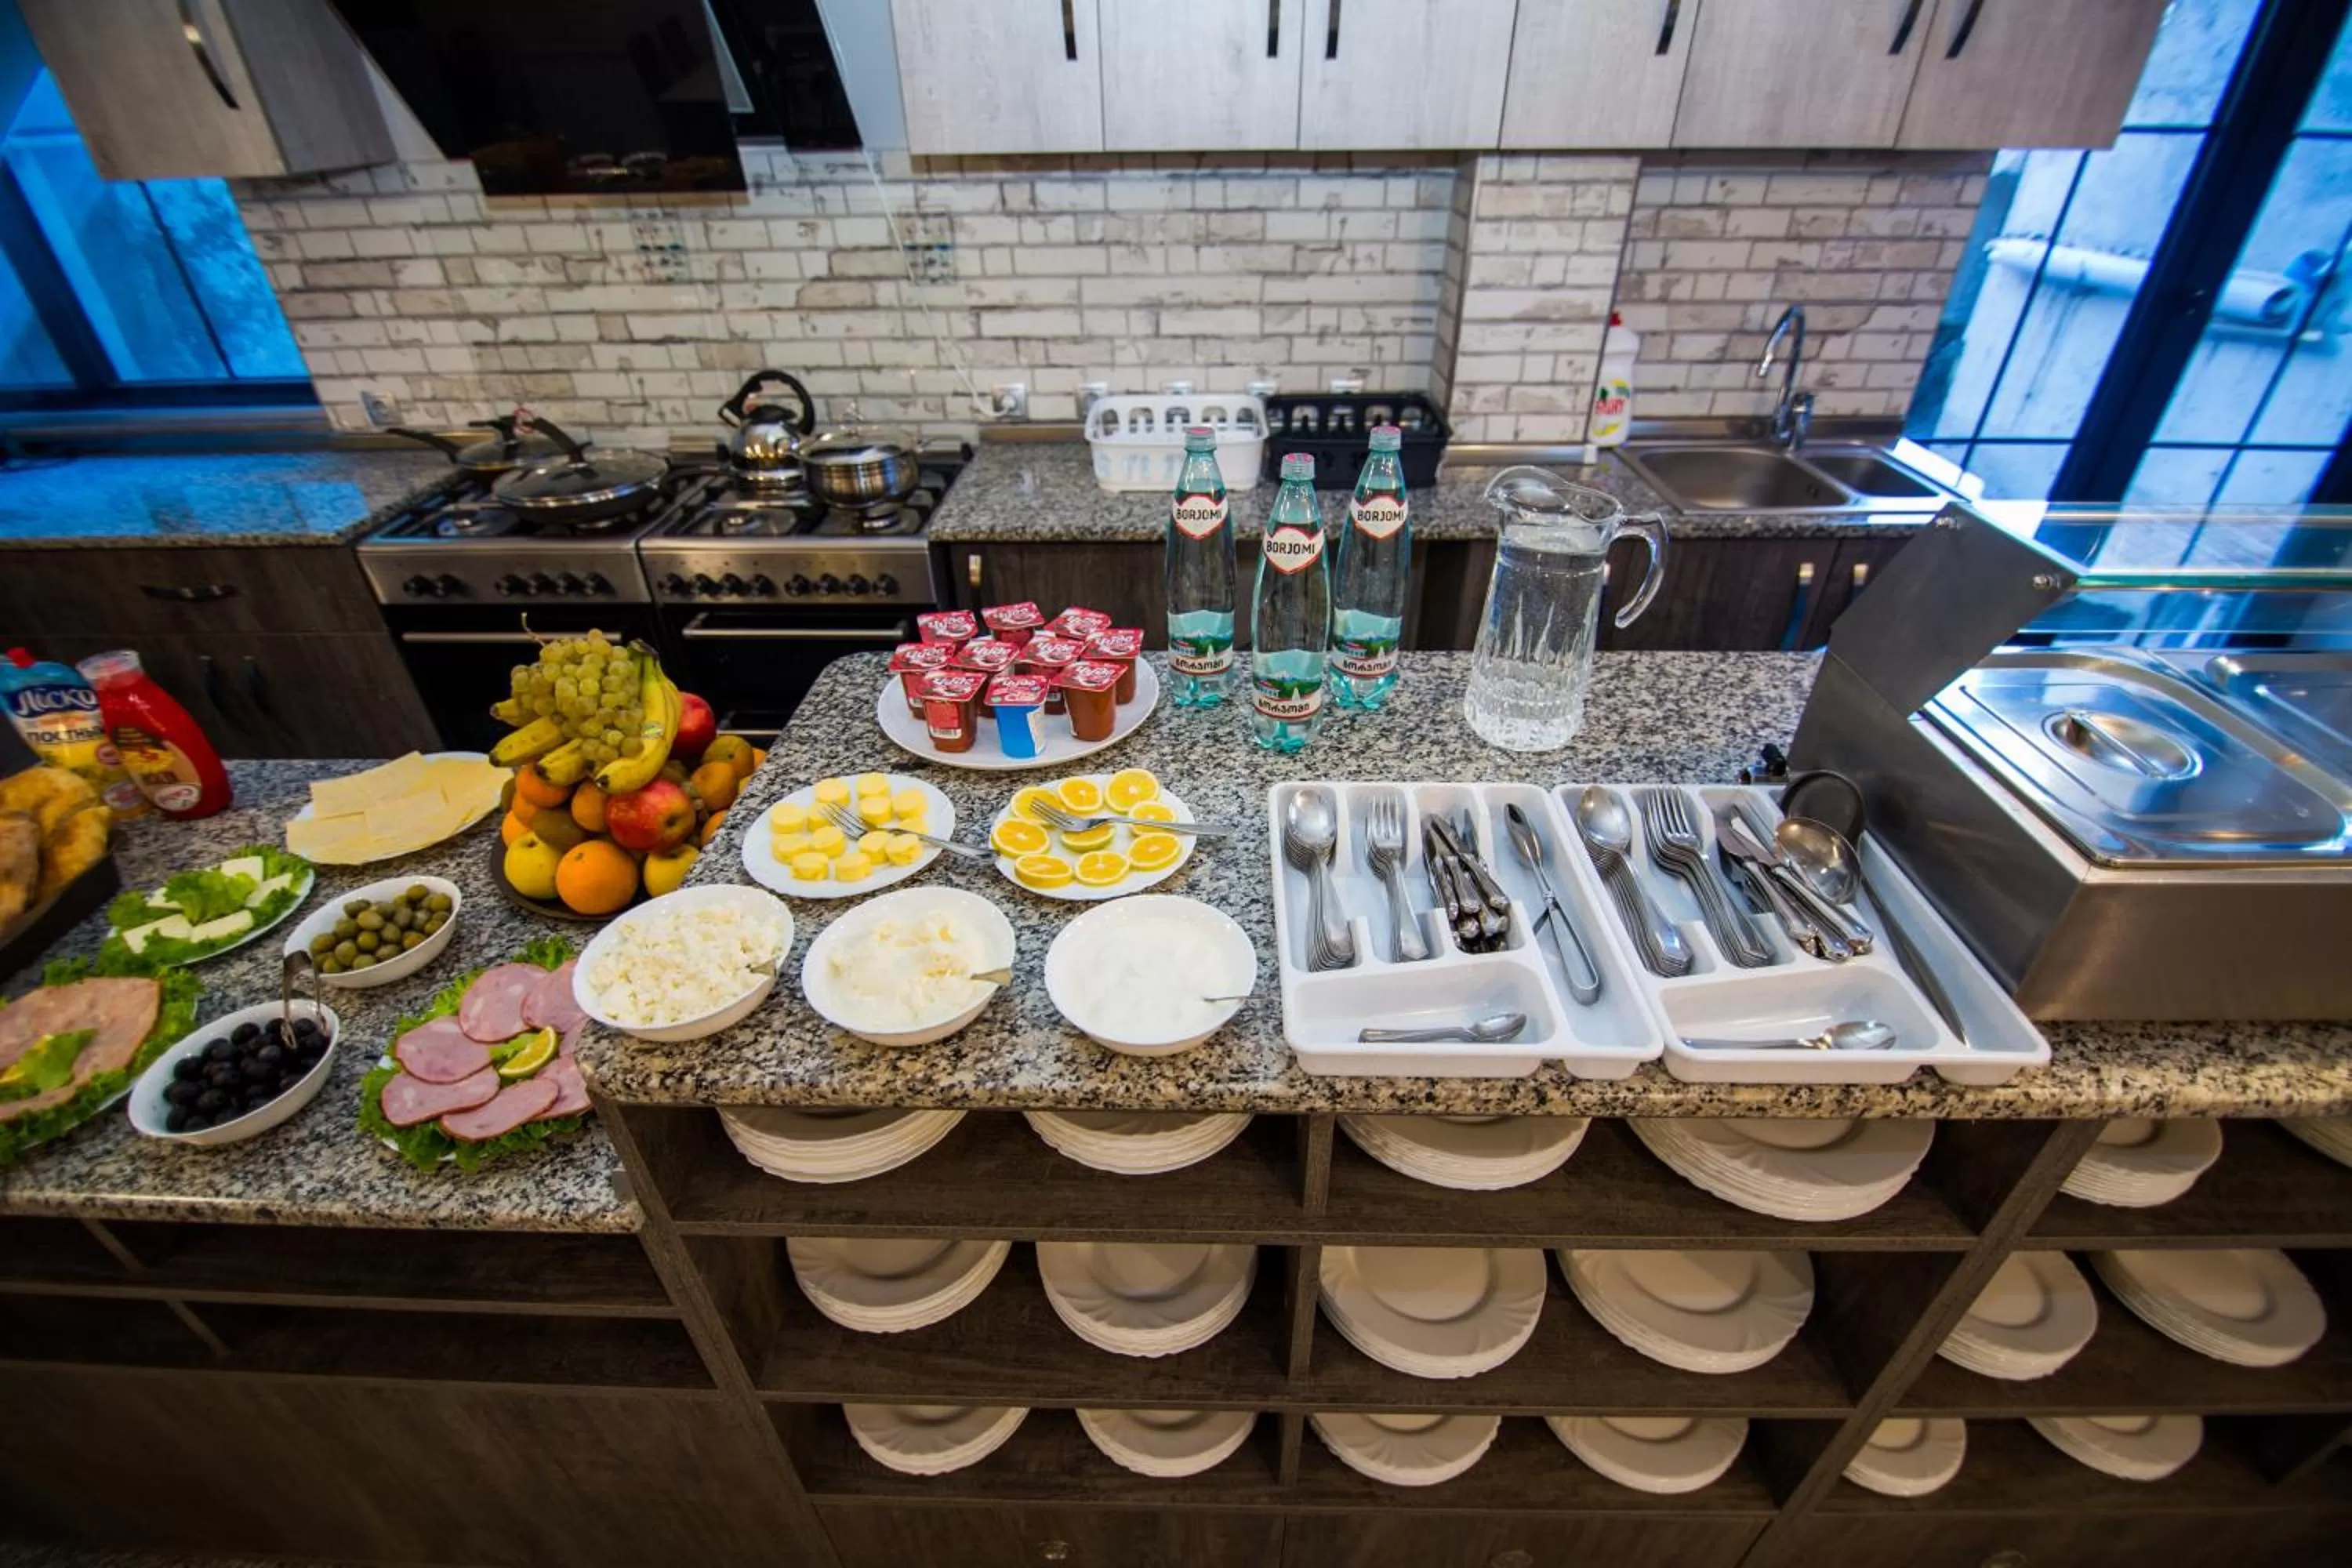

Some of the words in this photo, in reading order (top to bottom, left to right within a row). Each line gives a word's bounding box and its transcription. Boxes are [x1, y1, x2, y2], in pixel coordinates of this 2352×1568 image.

[1177, 508, 1221, 520] BORJOMI
[1357, 510, 1404, 521] BORJOMI
[1266, 541, 1316, 554] BORJOMI
